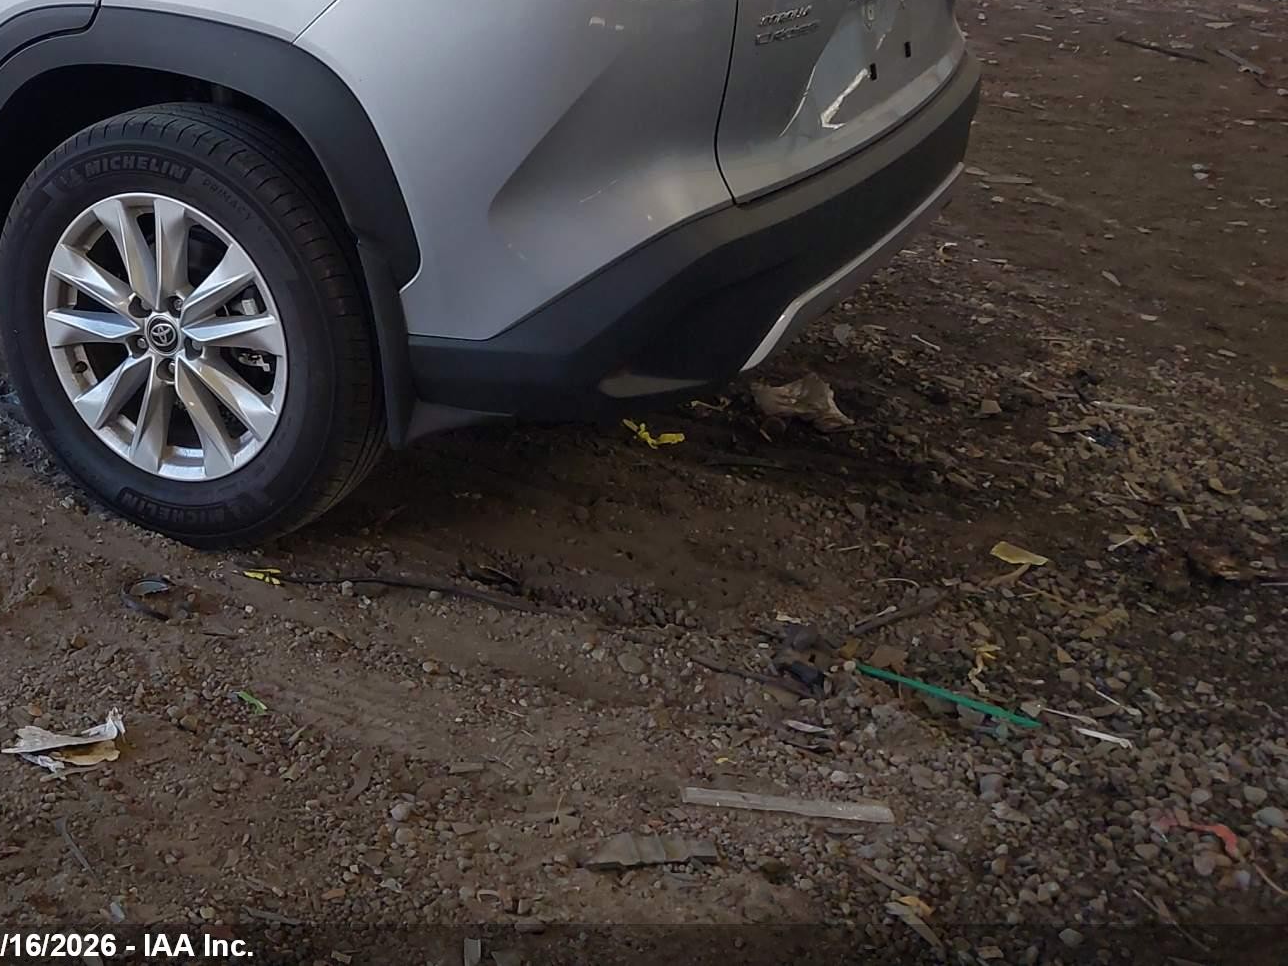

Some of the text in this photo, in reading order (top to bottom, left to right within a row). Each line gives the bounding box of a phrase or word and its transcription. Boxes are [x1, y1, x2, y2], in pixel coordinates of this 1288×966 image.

[84, 155, 187, 179] MICHELIN
[202, 179, 253, 221] PRIMACY
[121, 491, 226, 523] MICHELIN
